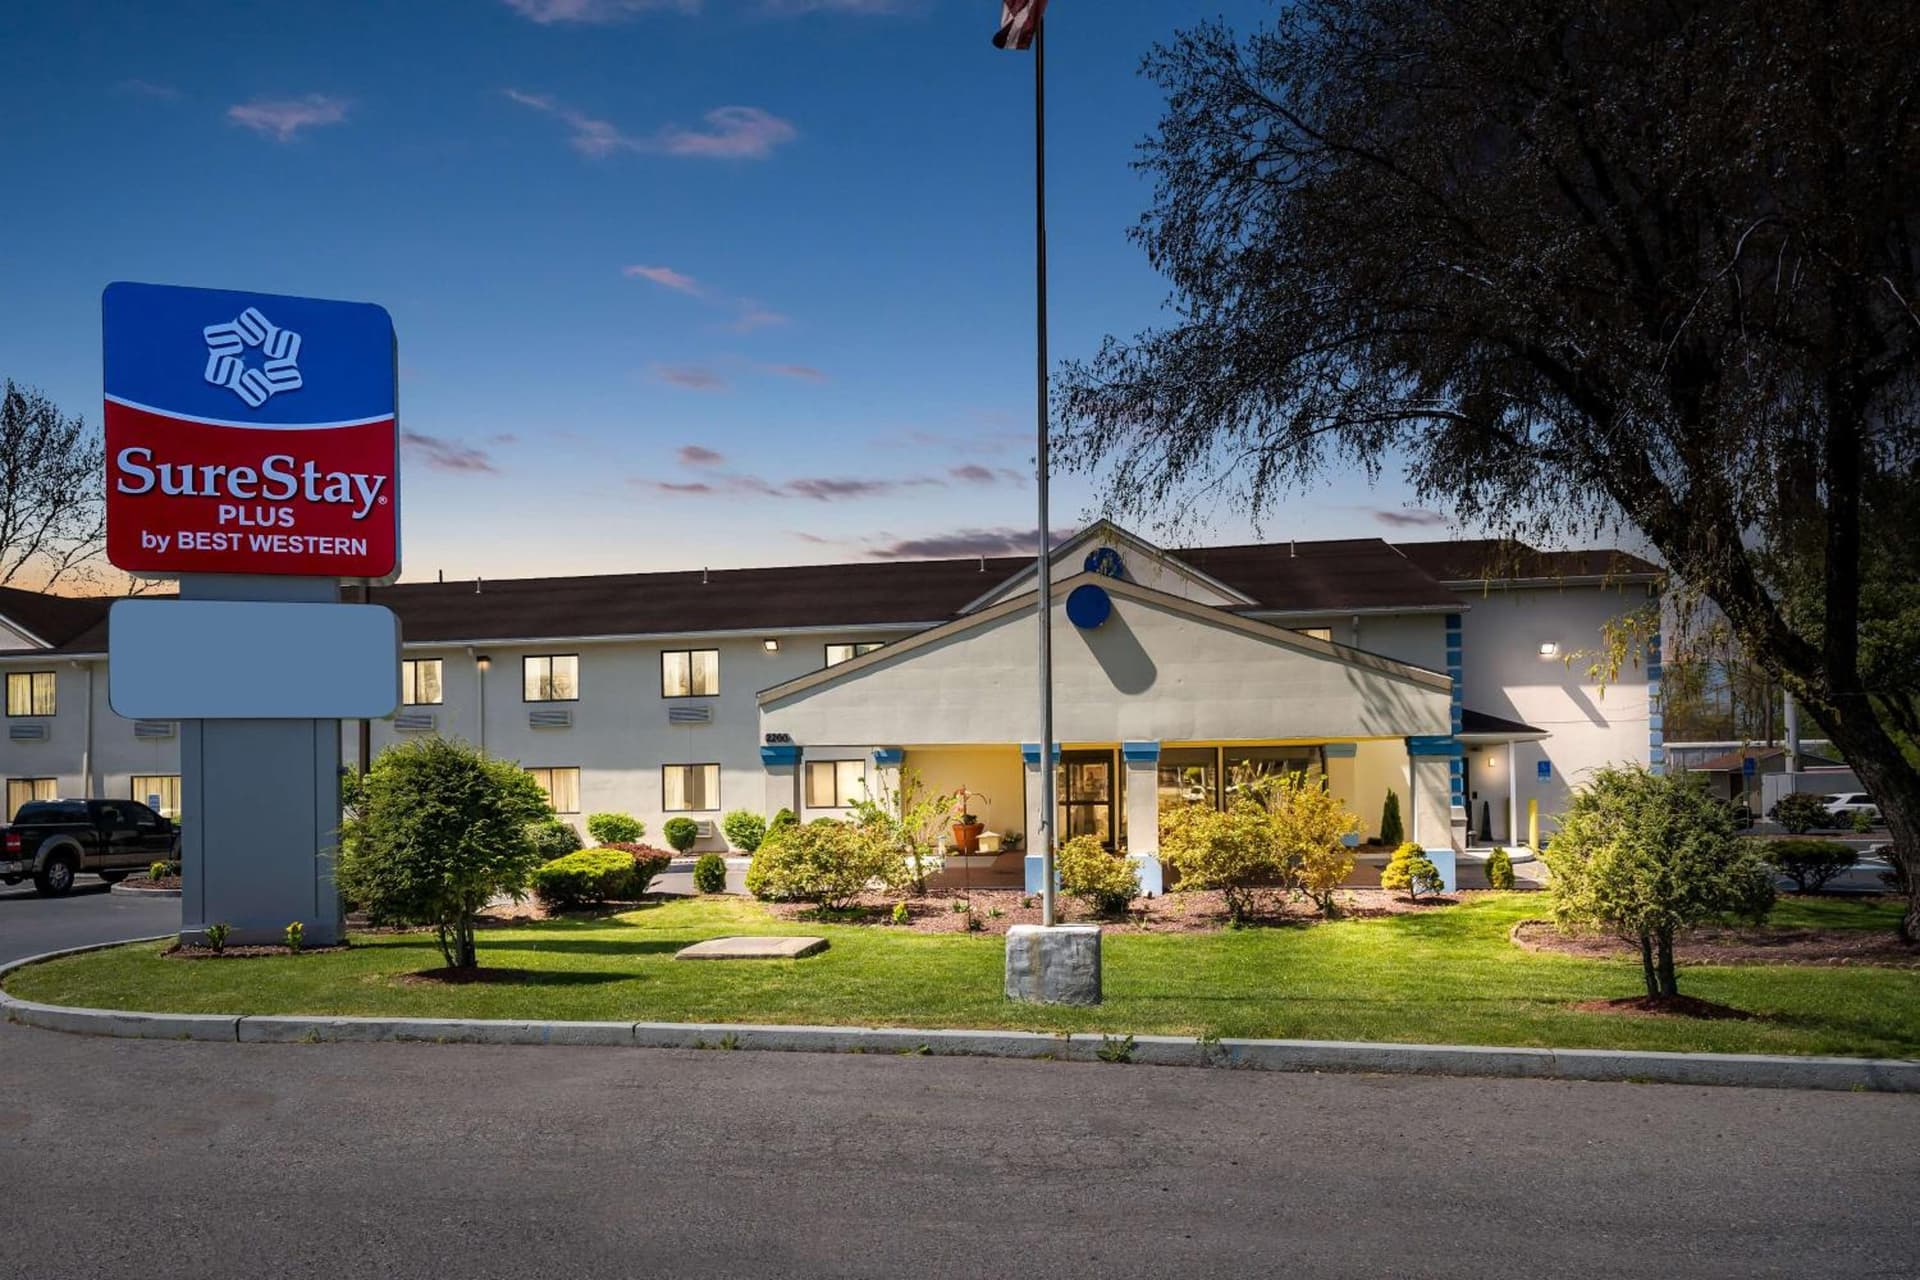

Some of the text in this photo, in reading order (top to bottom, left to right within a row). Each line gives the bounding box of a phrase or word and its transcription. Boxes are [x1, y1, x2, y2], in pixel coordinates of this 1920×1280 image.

[218, 505, 295, 527] PLUS
[142, 531, 367, 556] by BEST WESTERN
